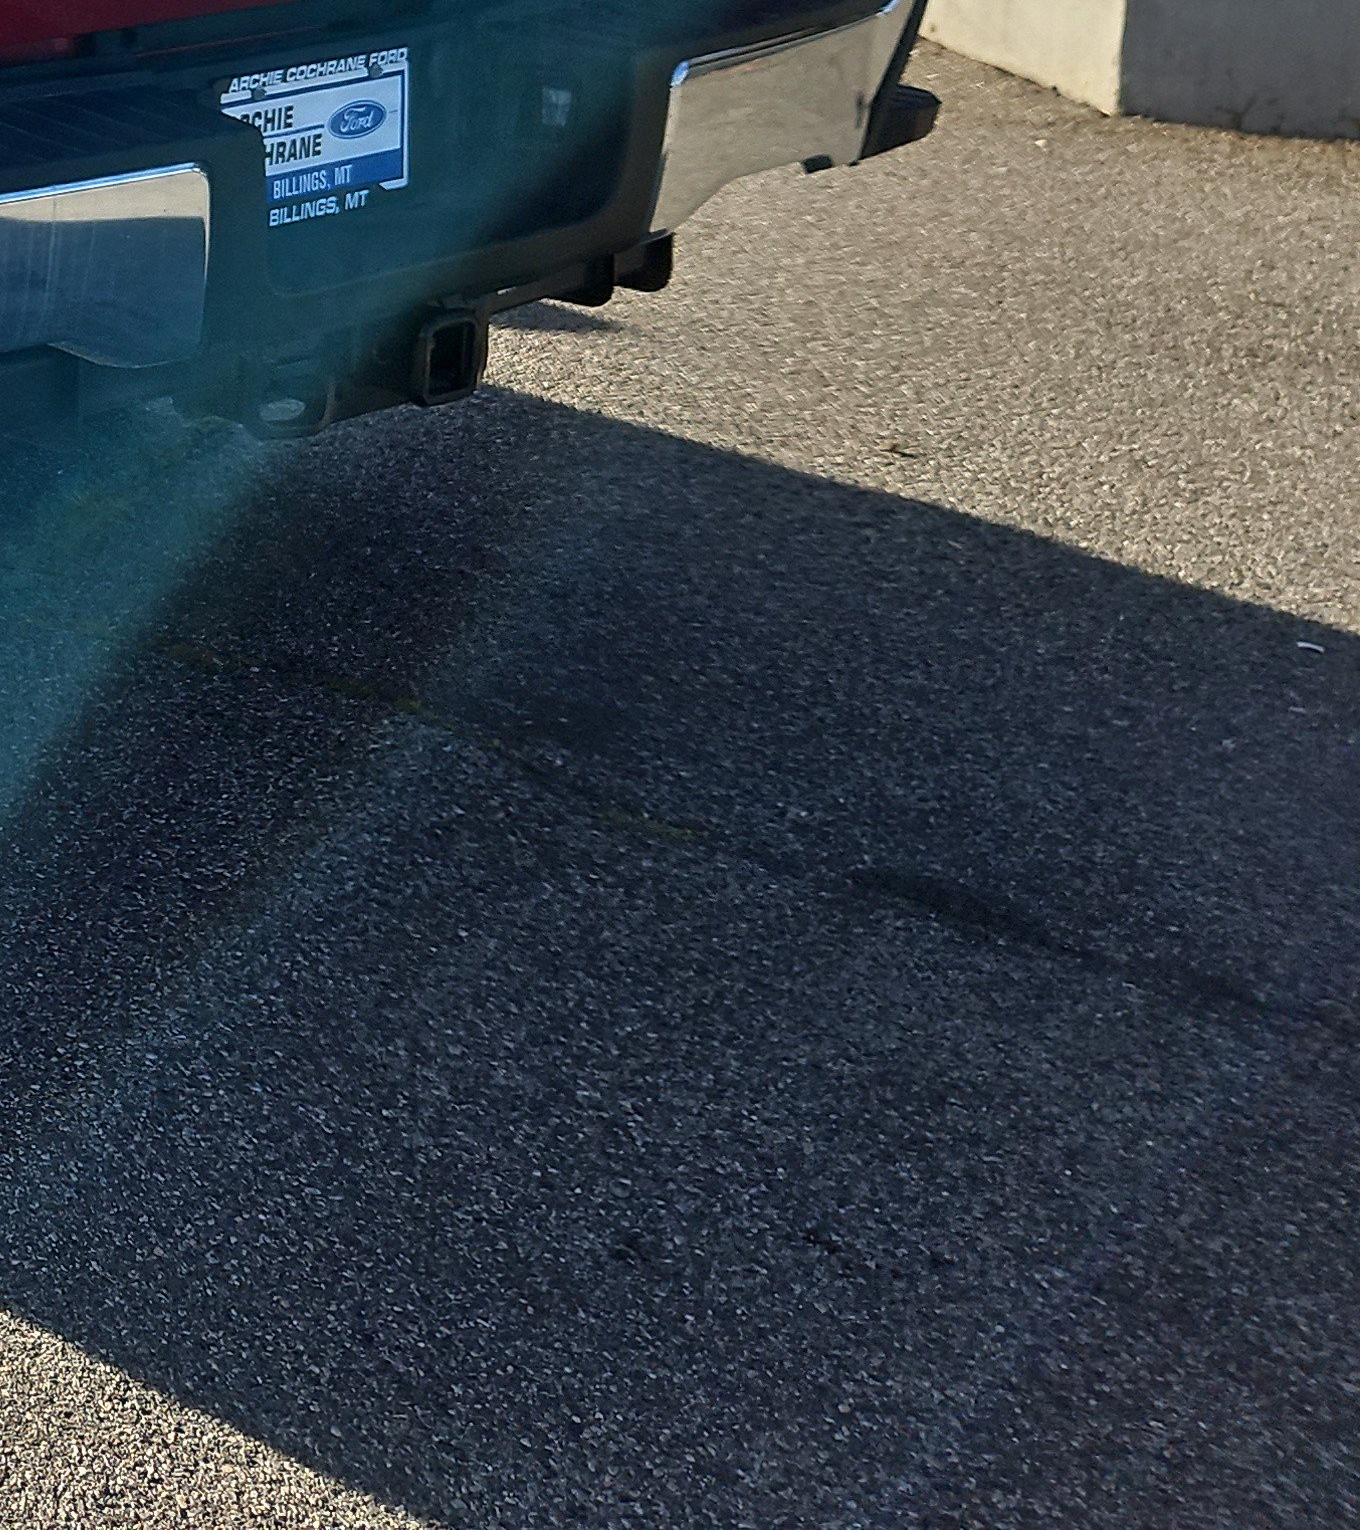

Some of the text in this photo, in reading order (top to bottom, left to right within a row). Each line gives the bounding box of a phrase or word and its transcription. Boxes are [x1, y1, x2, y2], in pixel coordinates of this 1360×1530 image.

[229, 47, 408, 92] ARCHIE COCHRANE FORD
[340, 106, 375, 133] Ford
[272, 164, 353, 199] BILLINGS, MT
[269, 189, 370, 227] BILLINGS, MT
